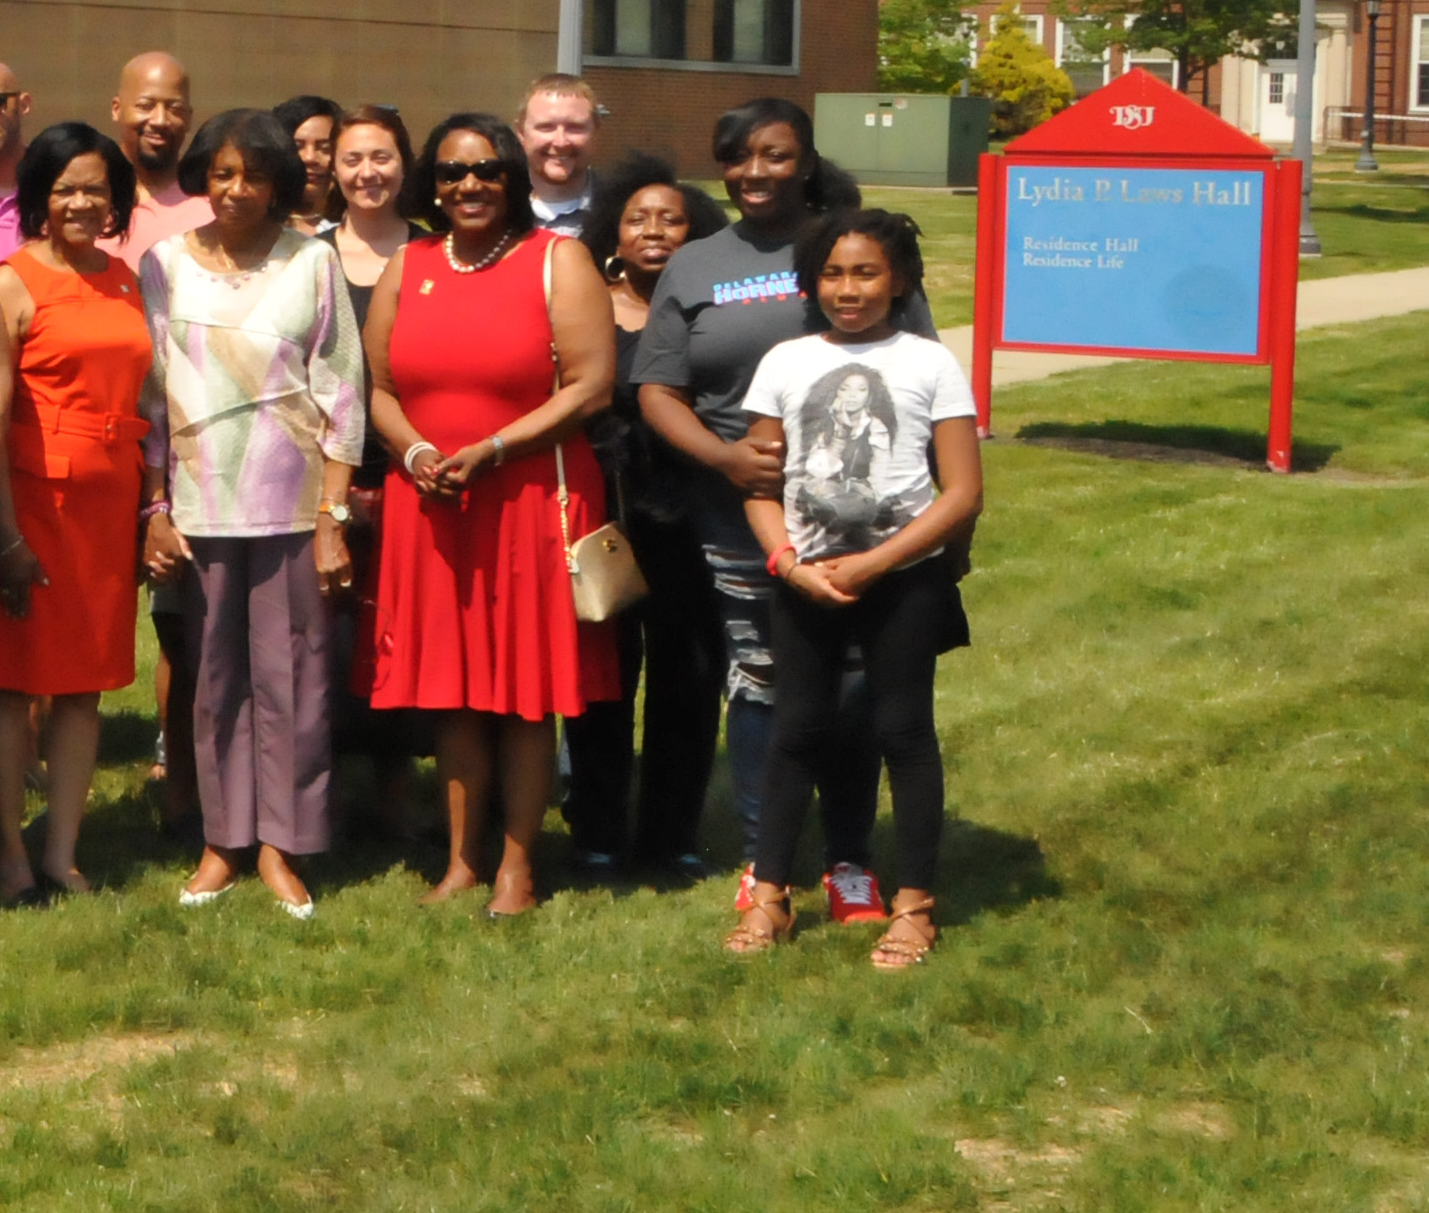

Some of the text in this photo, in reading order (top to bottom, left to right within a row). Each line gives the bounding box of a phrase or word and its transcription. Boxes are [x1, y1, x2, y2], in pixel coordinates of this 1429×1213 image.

[1109, 105, 1155, 130] DSU
[1017, 177, 1251, 207] Lydia P. Laws Hall
[1023, 236, 1138, 253] Residence Hall
[1023, 252, 1124, 269] Residence Life
[713, 278, 800, 306] HORNE
